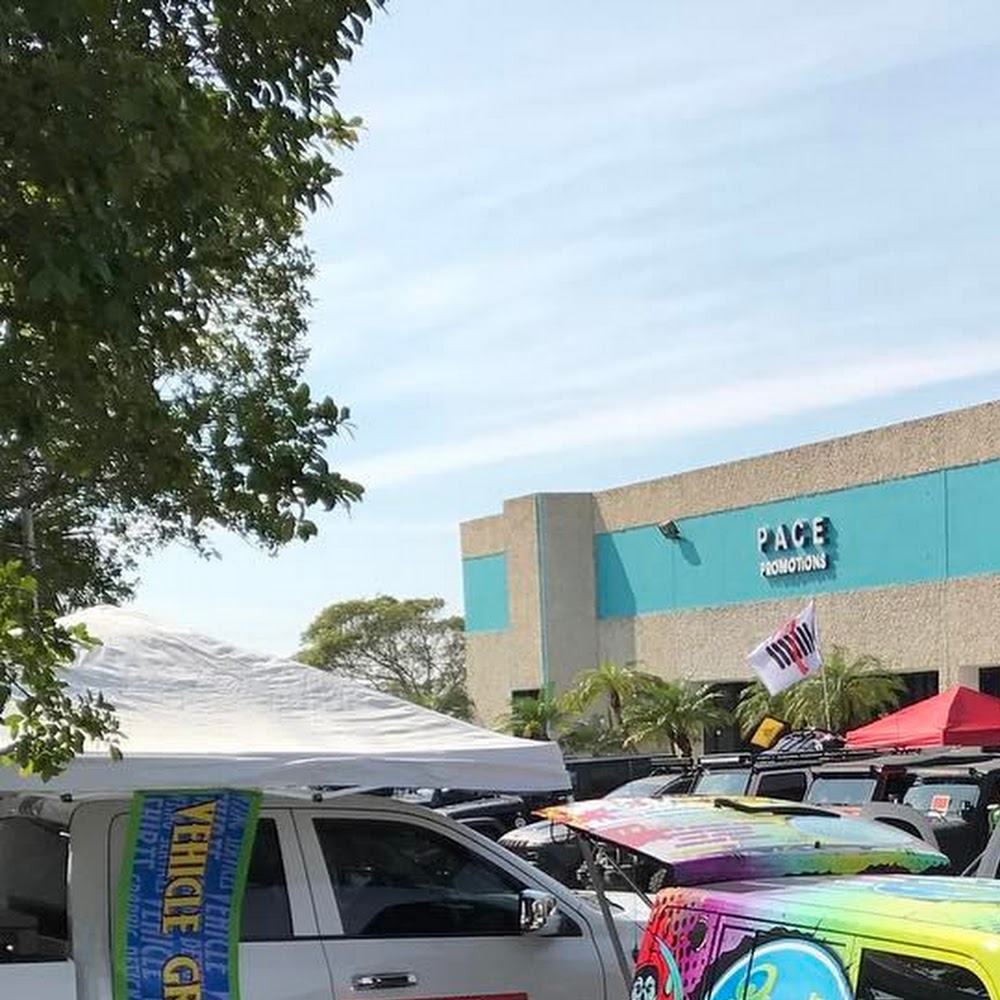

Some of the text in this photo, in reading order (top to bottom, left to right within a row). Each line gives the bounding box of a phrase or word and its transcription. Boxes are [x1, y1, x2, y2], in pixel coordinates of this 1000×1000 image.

[757, 516, 828, 551] PACE
[760, 553, 827, 576] PROMOTIONS
[161, 799, 217, 935] VEHICLE
